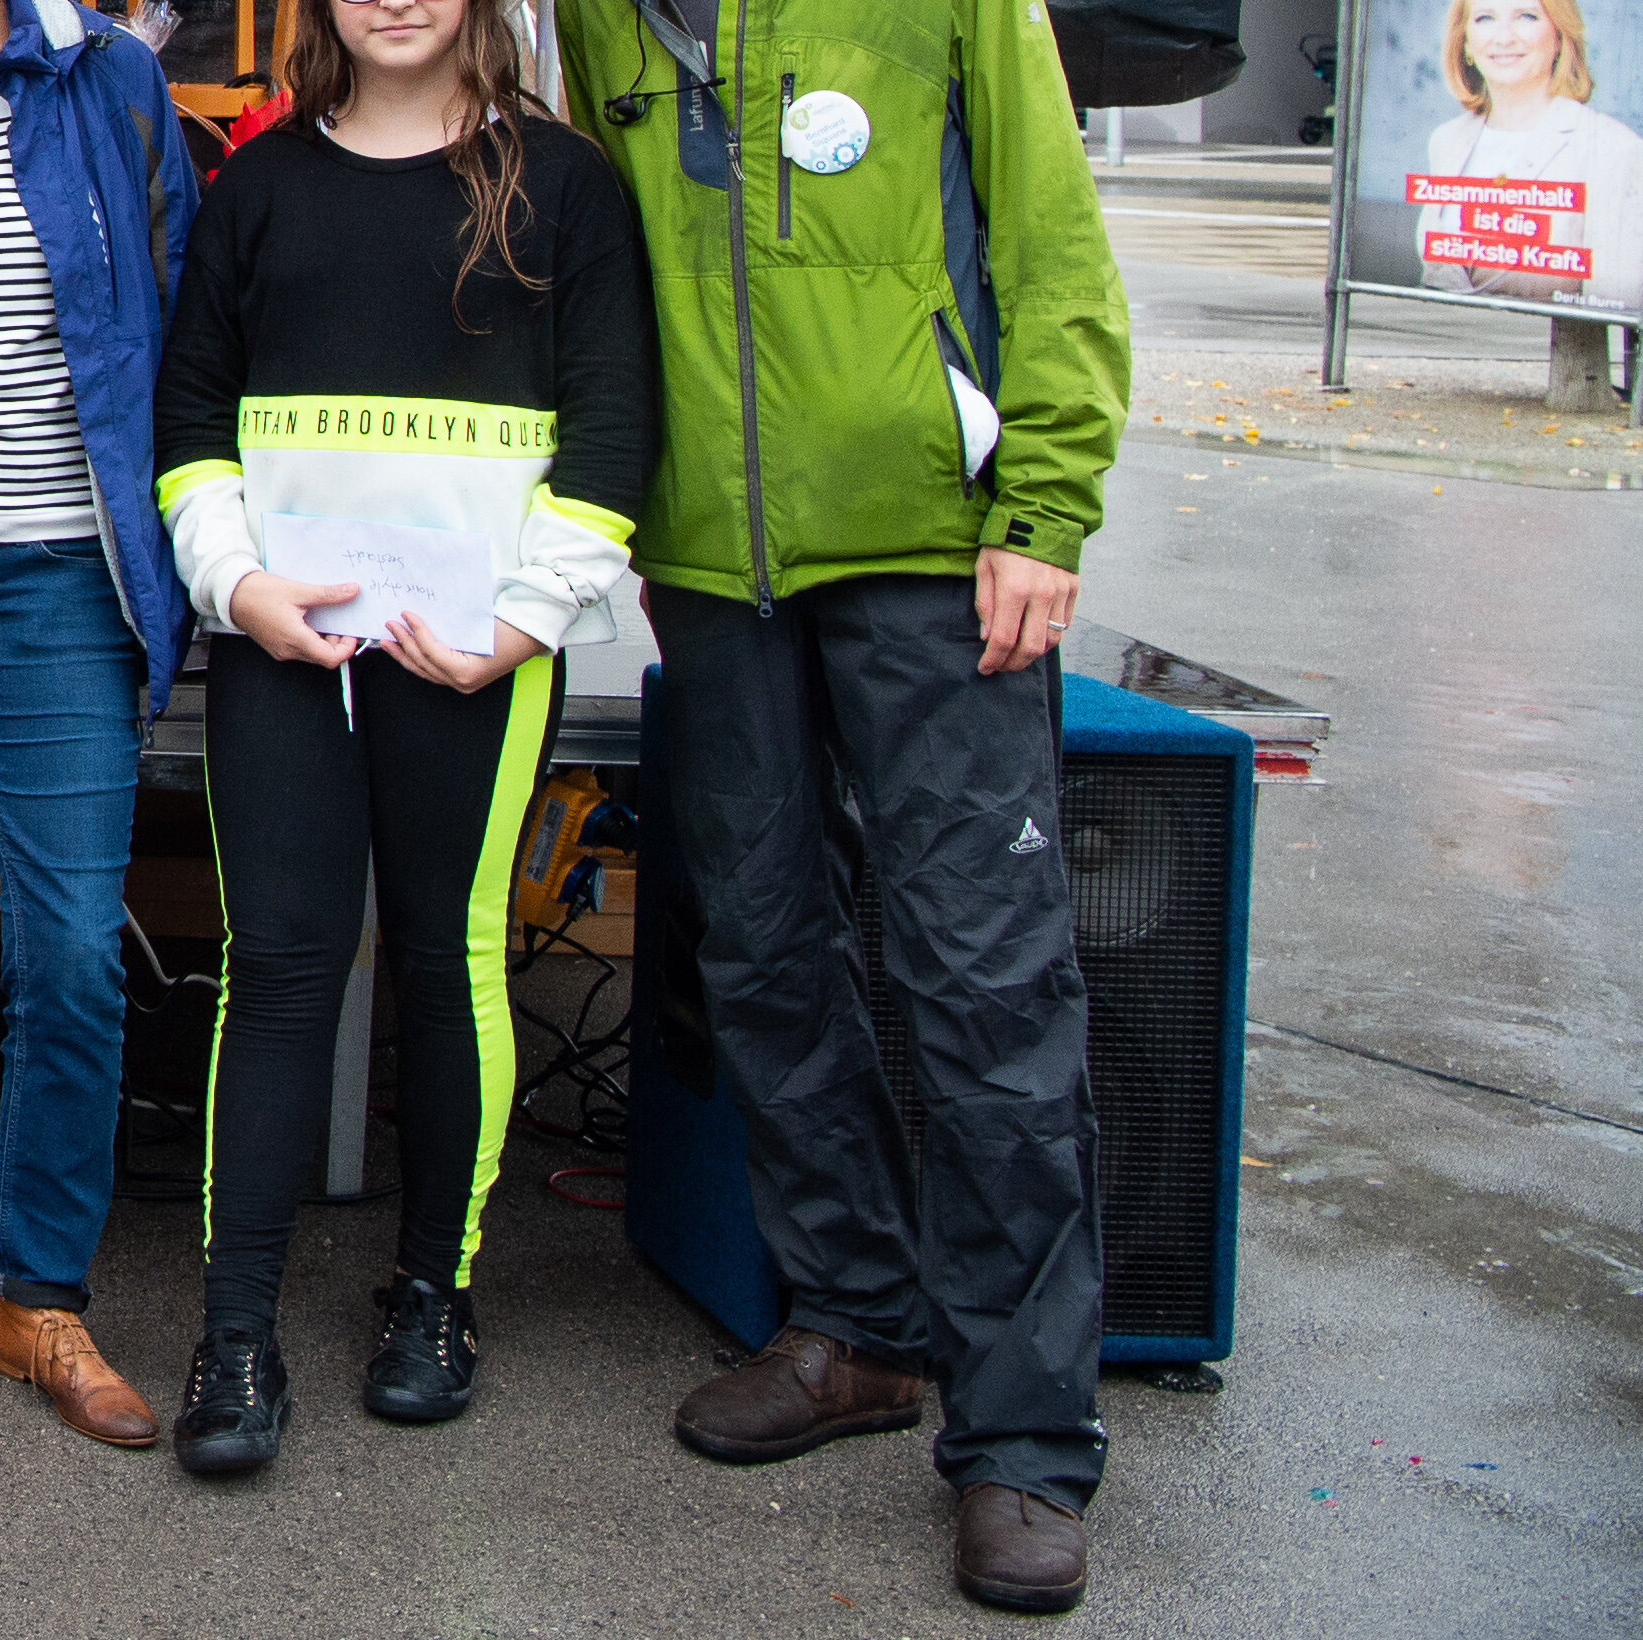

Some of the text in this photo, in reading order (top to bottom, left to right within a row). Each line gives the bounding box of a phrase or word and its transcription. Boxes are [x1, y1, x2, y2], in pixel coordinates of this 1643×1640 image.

[1413, 178, 1574, 209] Zusammenhalt
[1473, 209, 1537, 237] ist die
[1430, 237, 1587, 274] stärkste Kraft.
[317, 409, 476, 443] BROOKLYN
